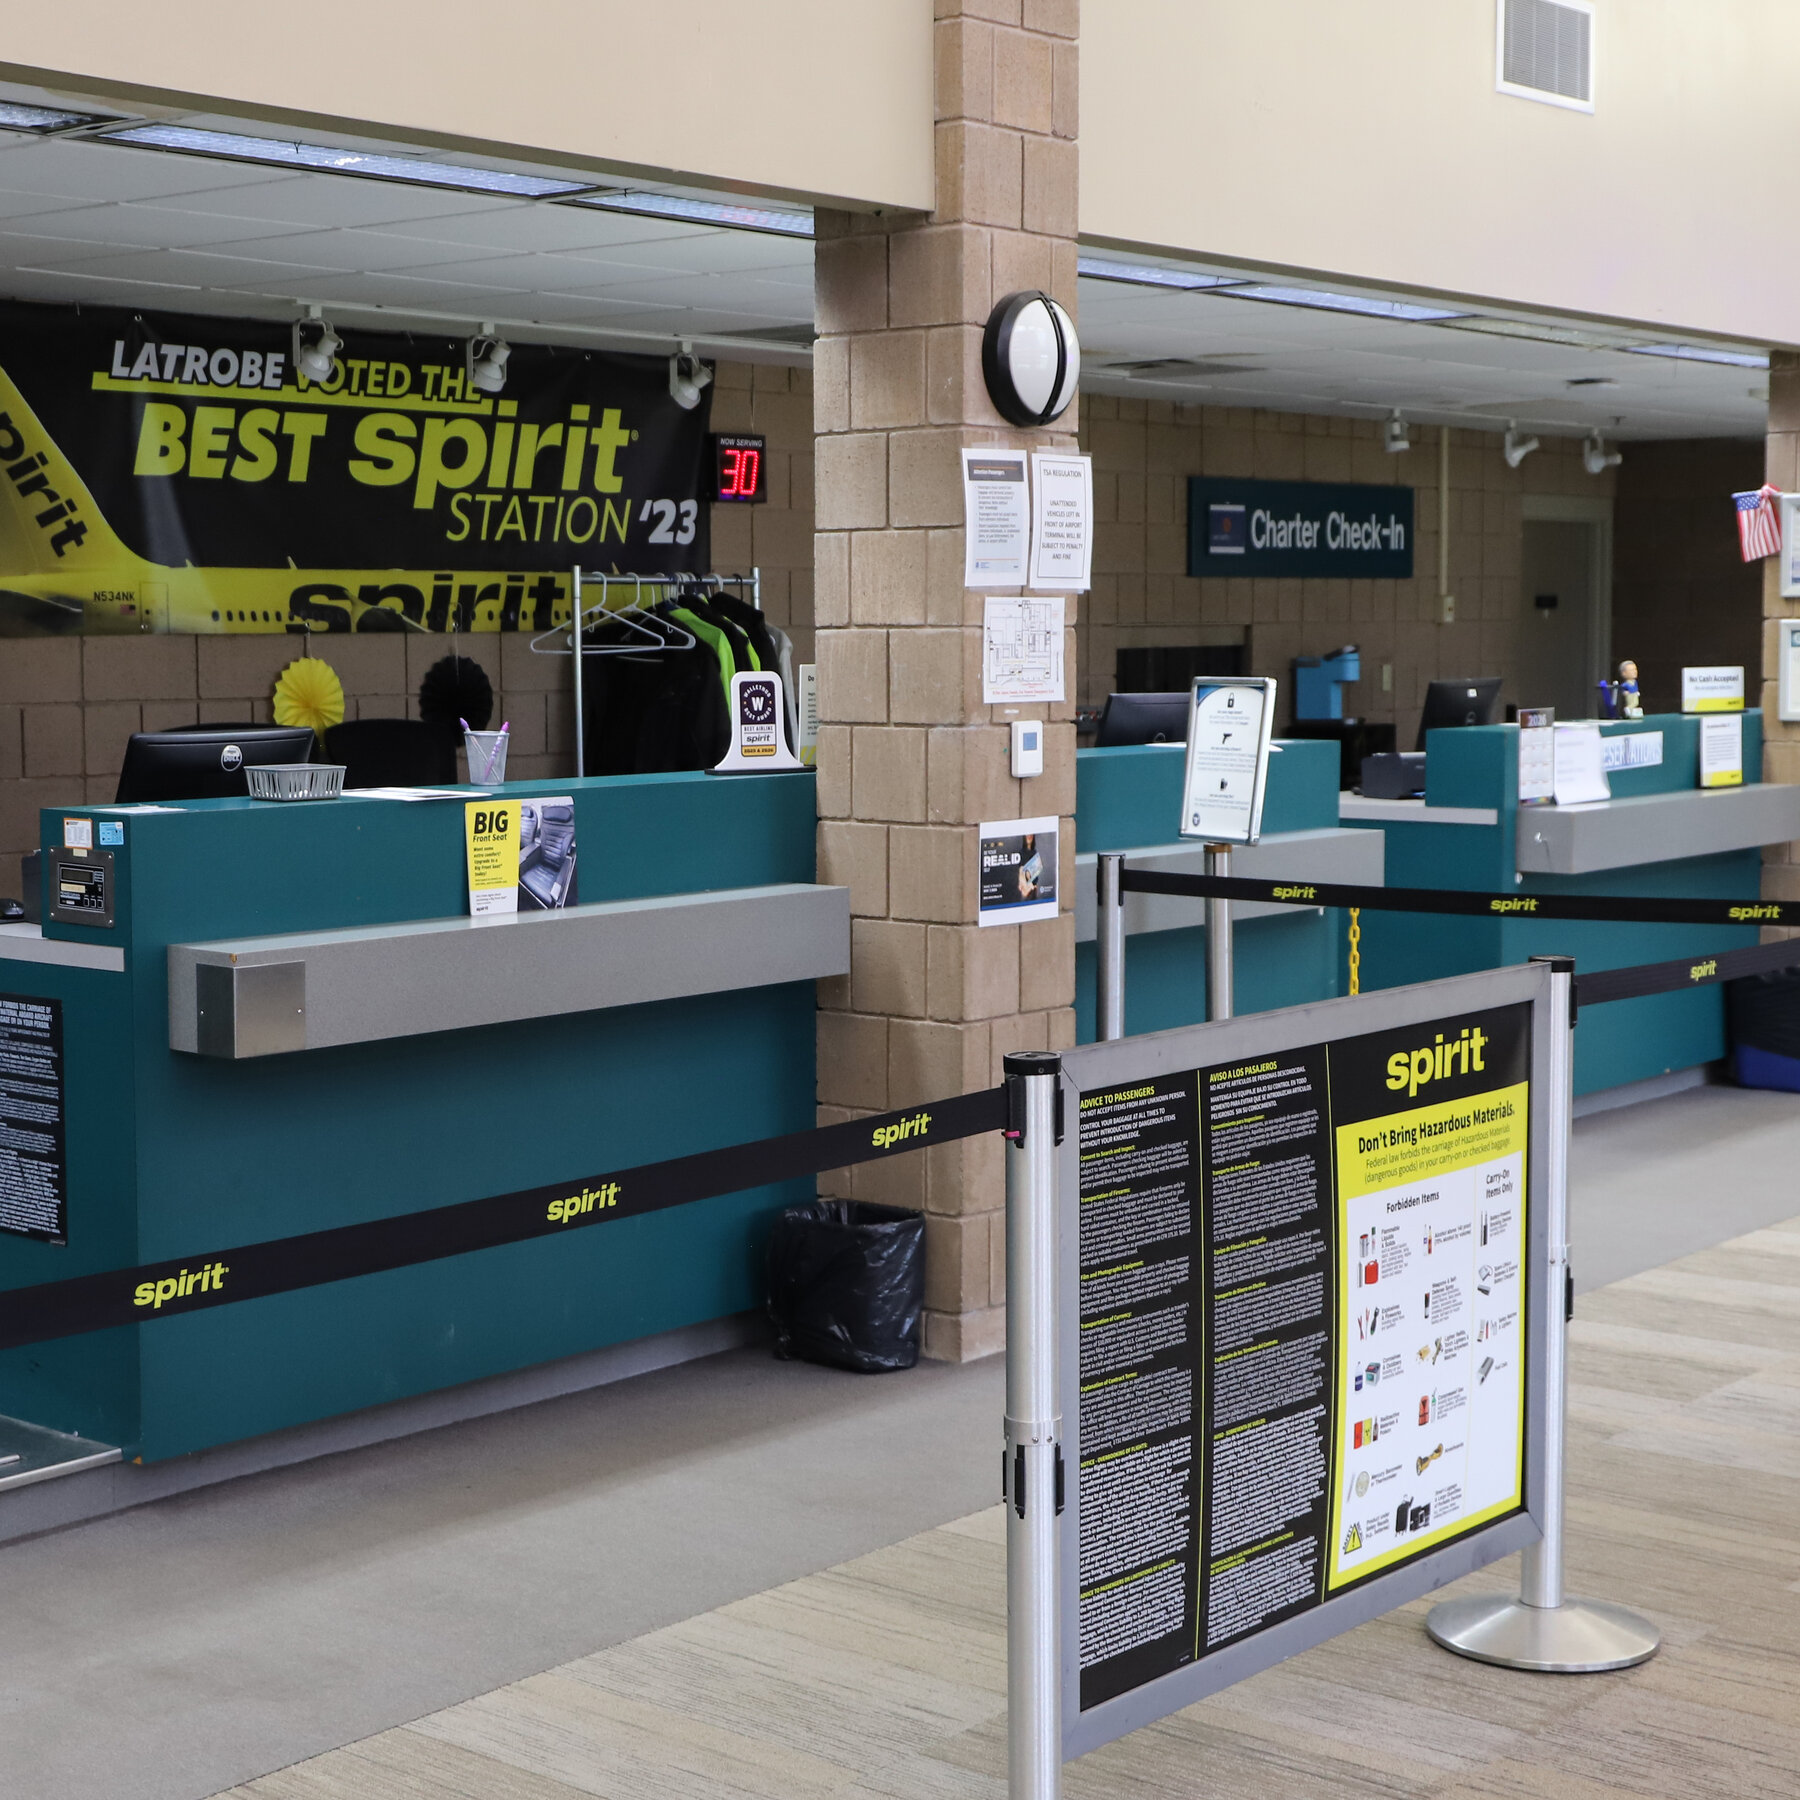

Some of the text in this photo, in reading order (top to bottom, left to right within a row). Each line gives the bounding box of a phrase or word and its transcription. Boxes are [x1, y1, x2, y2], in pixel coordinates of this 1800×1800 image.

[111, 339, 286, 388] LATROBE
[133, 399, 631, 510] BEST spirit
[720, 438, 763, 448] NOW SERVING
[721, 449, 760, 495] 30
[1052, 469, 1082, 478] REGULATION
[0, 411, 88, 558] pirit
[446, 492, 631, 544] STATION
[1251, 509, 1405, 550] Charter Check-In
[752, 696, 764, 711] W
[1604, 737, 1661, 766] ESERVATIONS
[474, 810, 508, 834] BIG
[984, 853, 1021, 867] REAL ID
[1273, 885, 1317, 900] spirit
[1490, 898, 1539, 912] spirit
[1729, 904, 1781, 921] spirit
[1691, 960, 1717, 980] spirit
[1209, 1061, 1277, 1083] AVISO A LOS PASAJEROS
[1386, 1027, 1485, 1098] spirit
[1080, 1086, 1154, 1109] ADVICE TO PASSENGERS
[871, 1112, 933, 1149] spirit
[1389, 1124, 1417, 1149] Bring
[1419, 1112, 1471, 1138] Hazardous
[1473, 1100, 1514, 1124] Materials.
[1486, 1169, 1510, 1185] Carry-On
[546, 1183, 621, 1225] spirit
[1386, 1190, 1439, 1213] Forbidden Items
[133, 1262, 230, 1310] spirit
